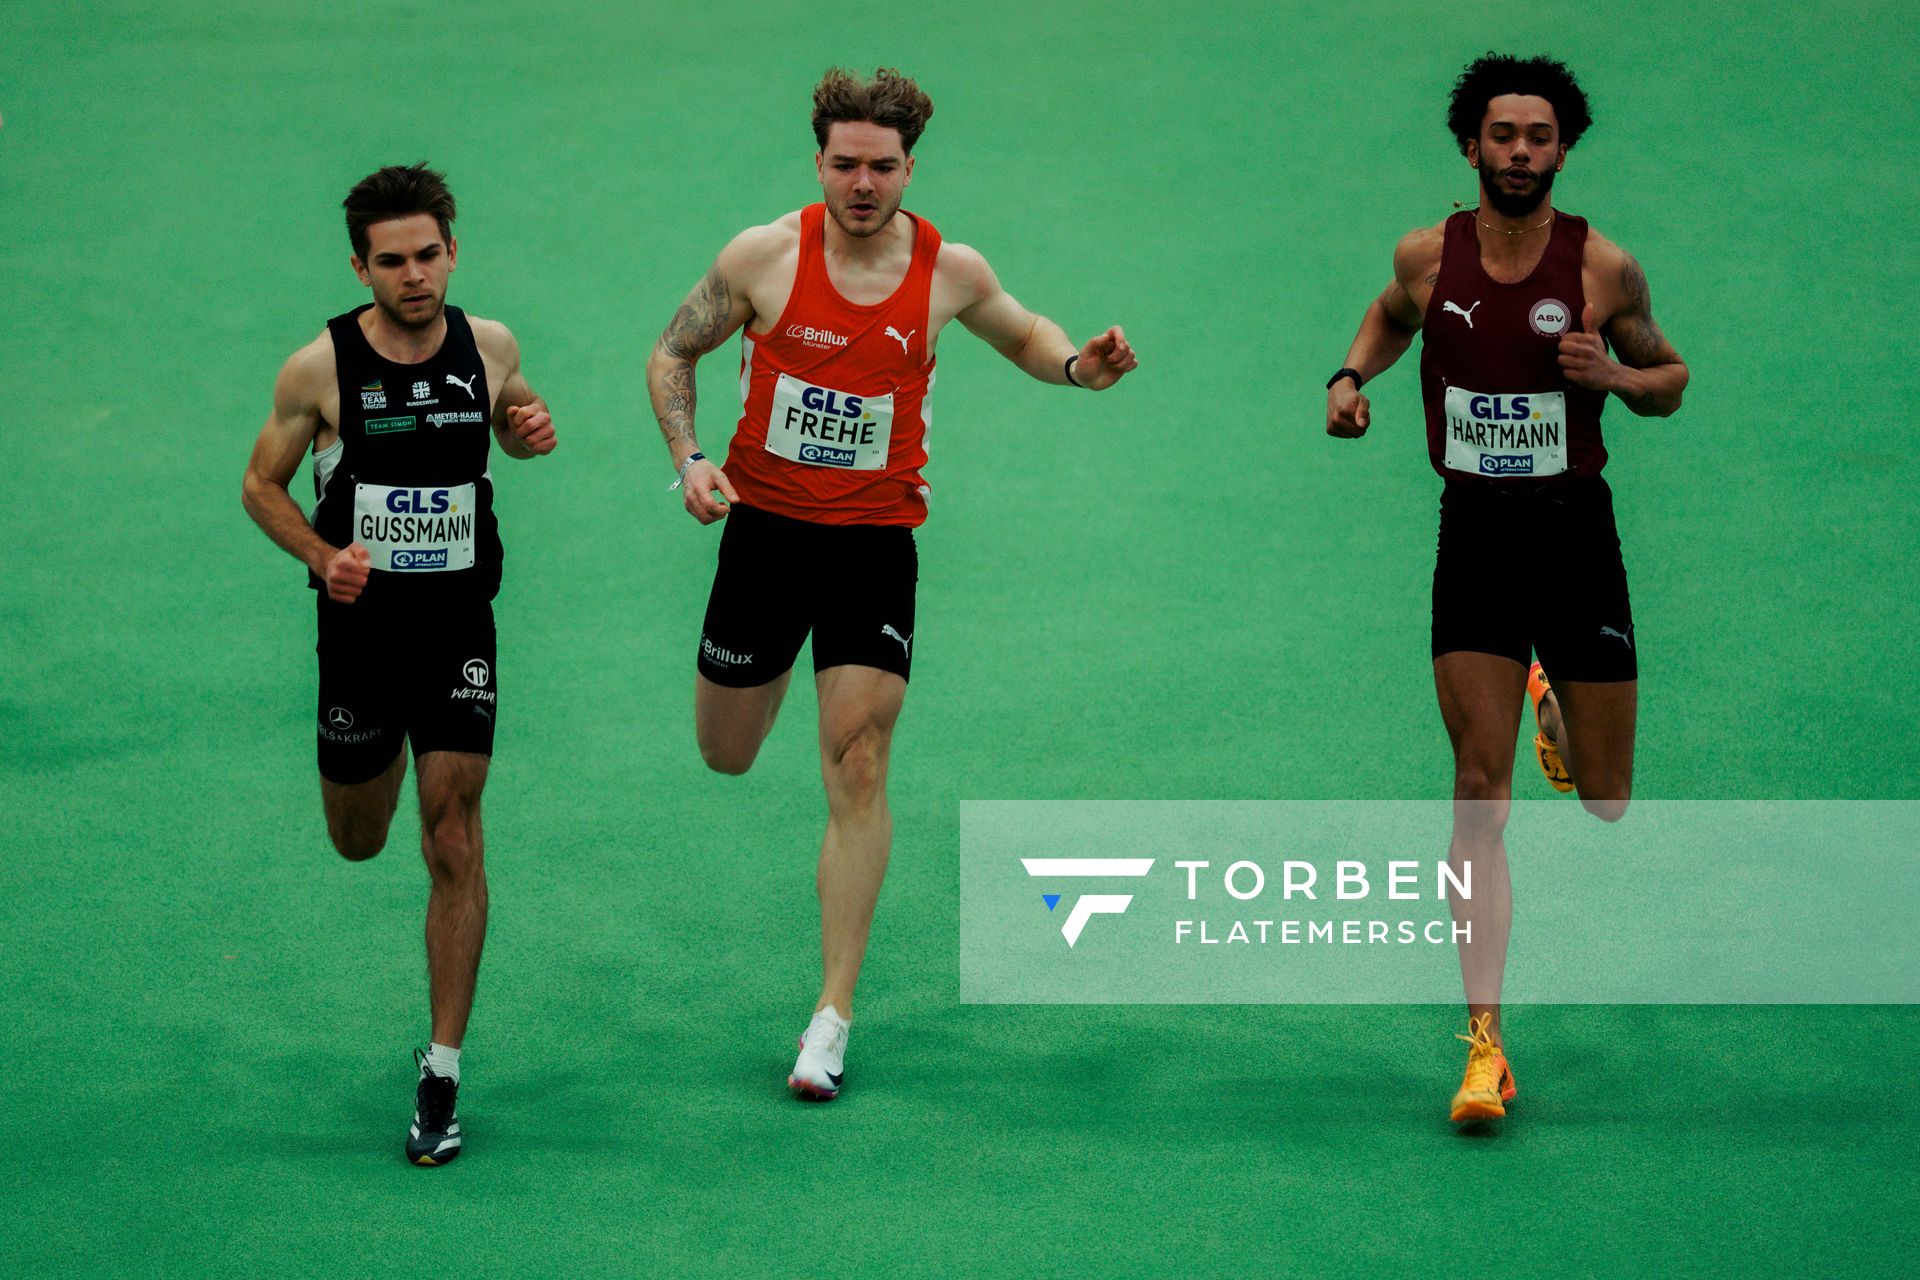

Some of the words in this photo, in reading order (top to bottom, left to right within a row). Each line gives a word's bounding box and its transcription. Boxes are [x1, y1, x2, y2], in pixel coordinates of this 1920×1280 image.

[1536, 314, 1564, 323] ASV
[803, 326, 849, 346] Brillux
[802, 340, 831, 350] Münster
[361, 396, 387, 404] TEAM
[406, 399, 440, 407] BUNDESWEHR
[434, 412, 483, 420] MEYER-HAAKE
[785, 406, 877, 445] FREHE
[1452, 416, 1559, 449] HARTMANN
[822, 450, 854, 462] PLAN
[1500, 458, 1531, 468] PLAN
[361, 513, 471, 543] GUSSMANN
[415, 553, 445, 562] PLAN
[704, 638, 753, 665] Brillux
